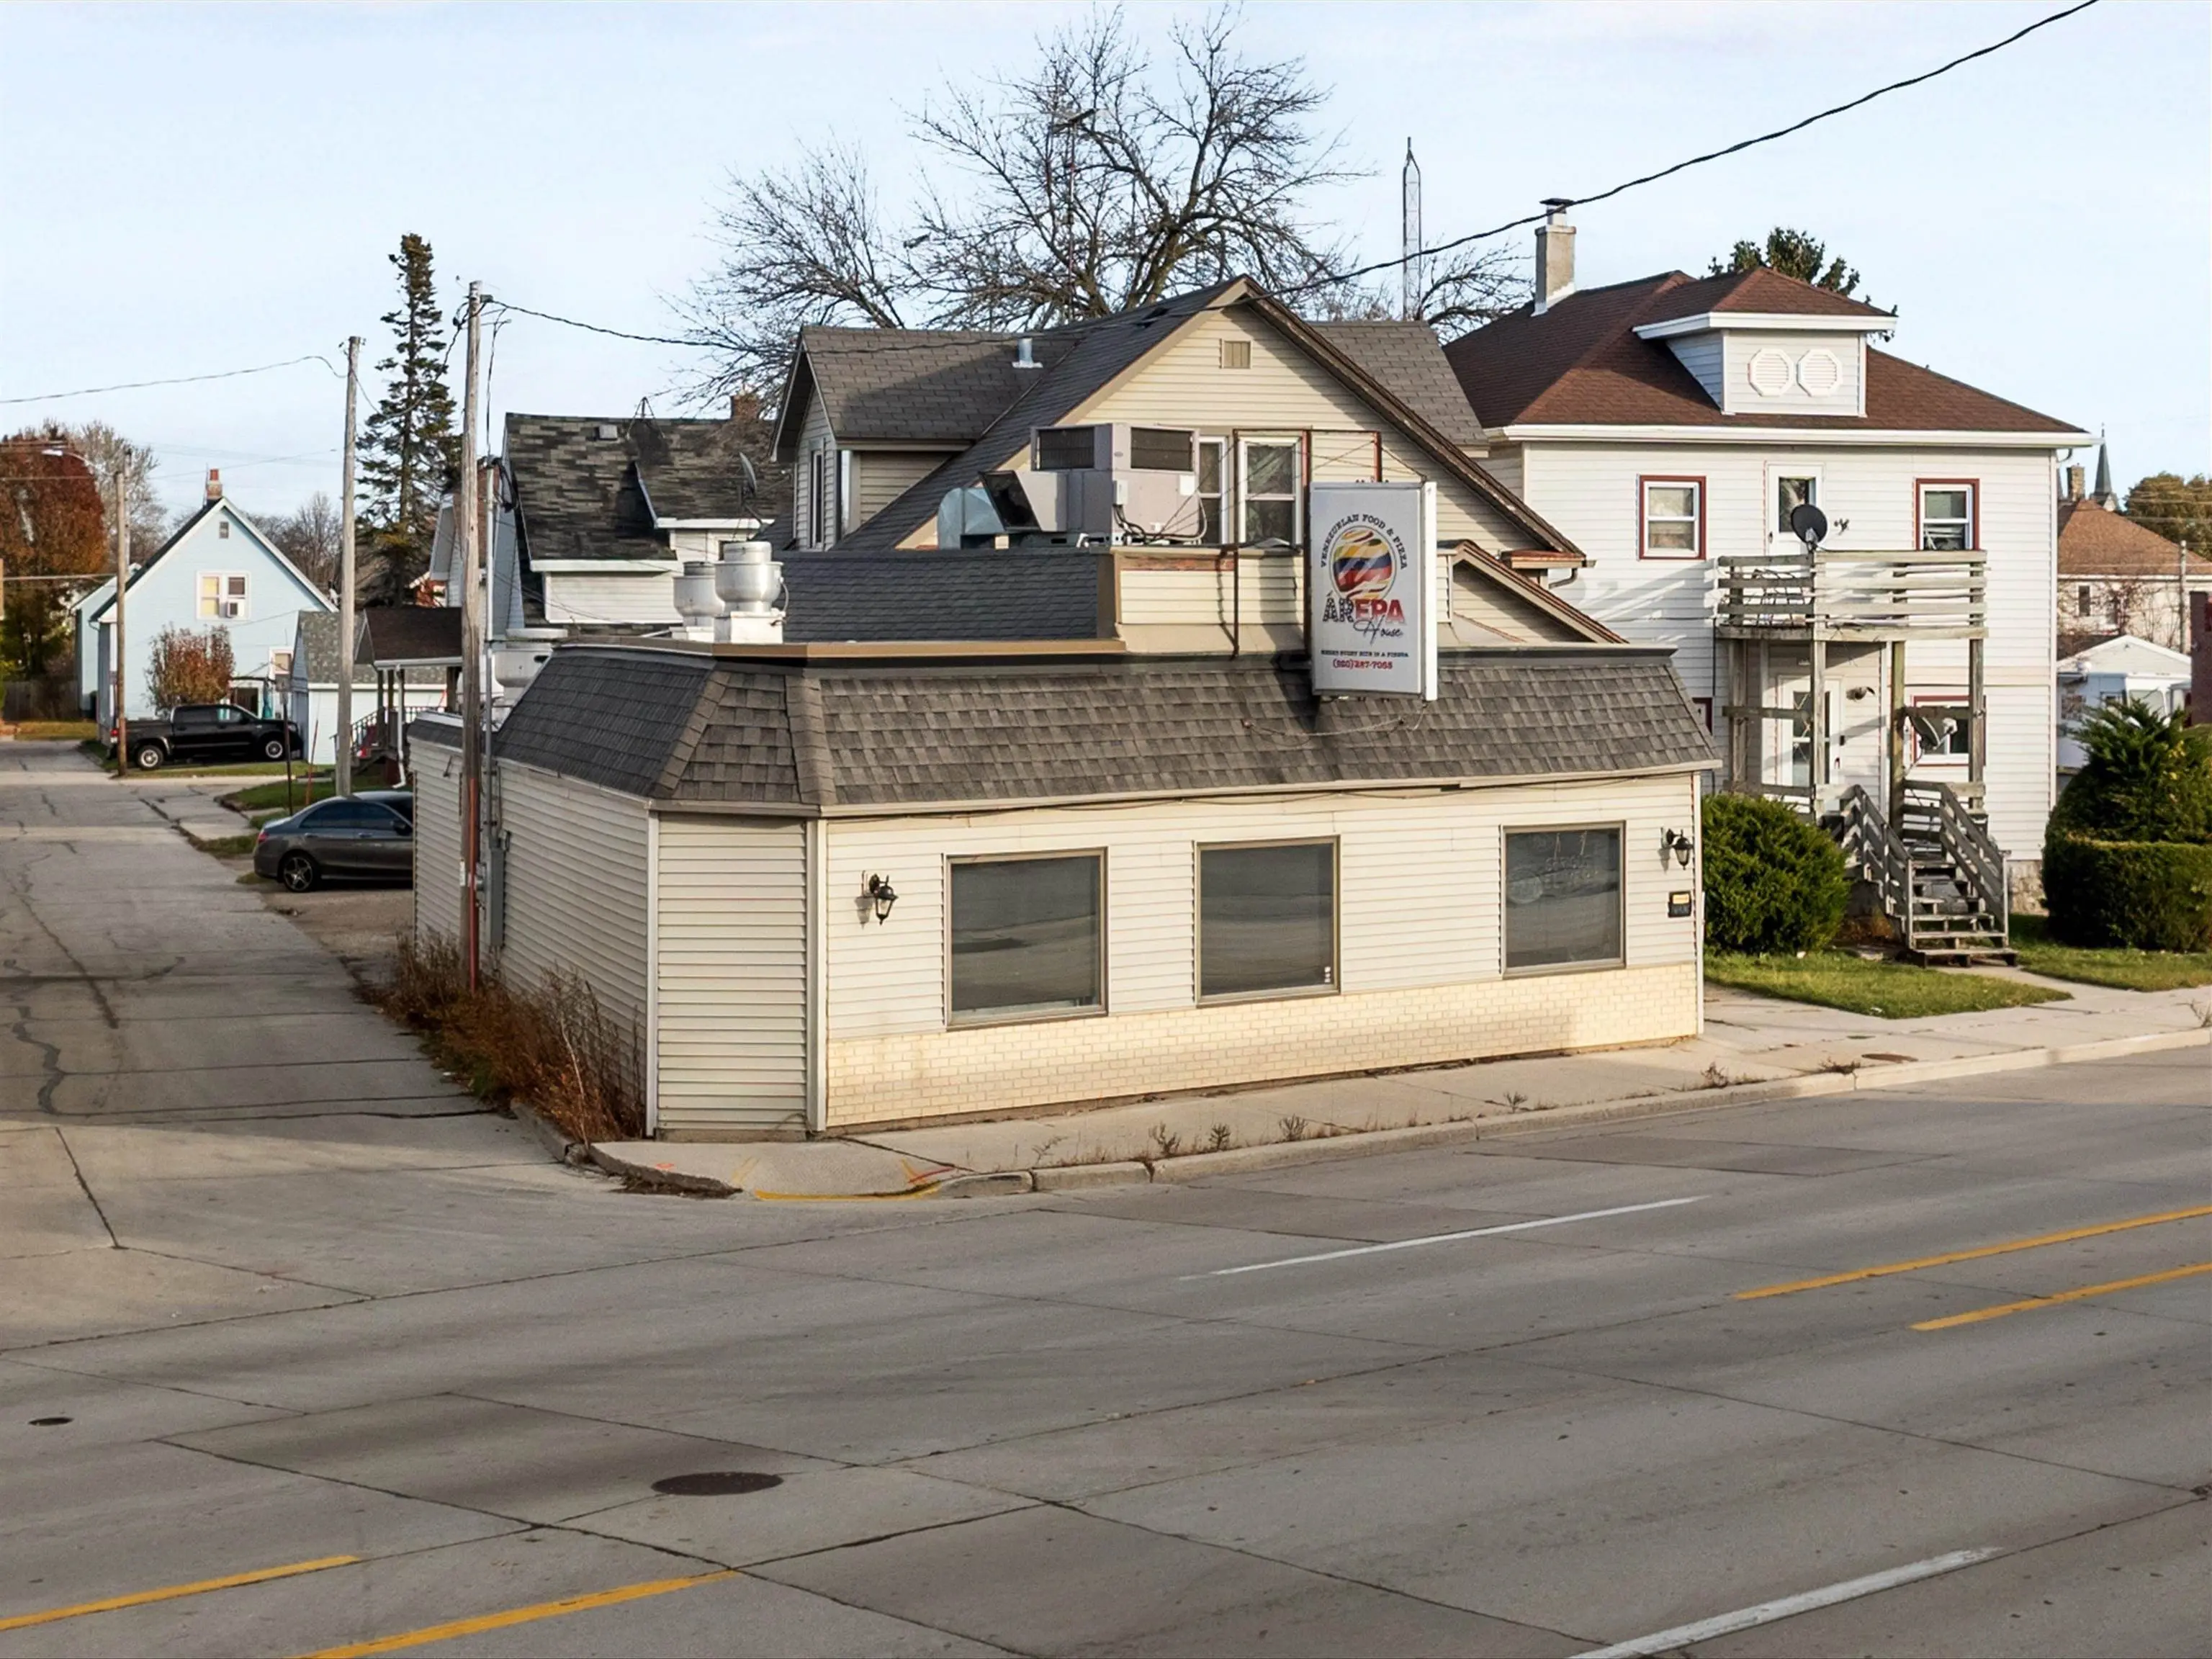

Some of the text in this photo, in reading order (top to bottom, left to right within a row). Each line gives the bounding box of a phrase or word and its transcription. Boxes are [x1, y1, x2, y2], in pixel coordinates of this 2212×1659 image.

[1321, 514, 1408, 570] VENEZUELAN FOOD & PIZZA
[1353, 615, 1403, 645] House
